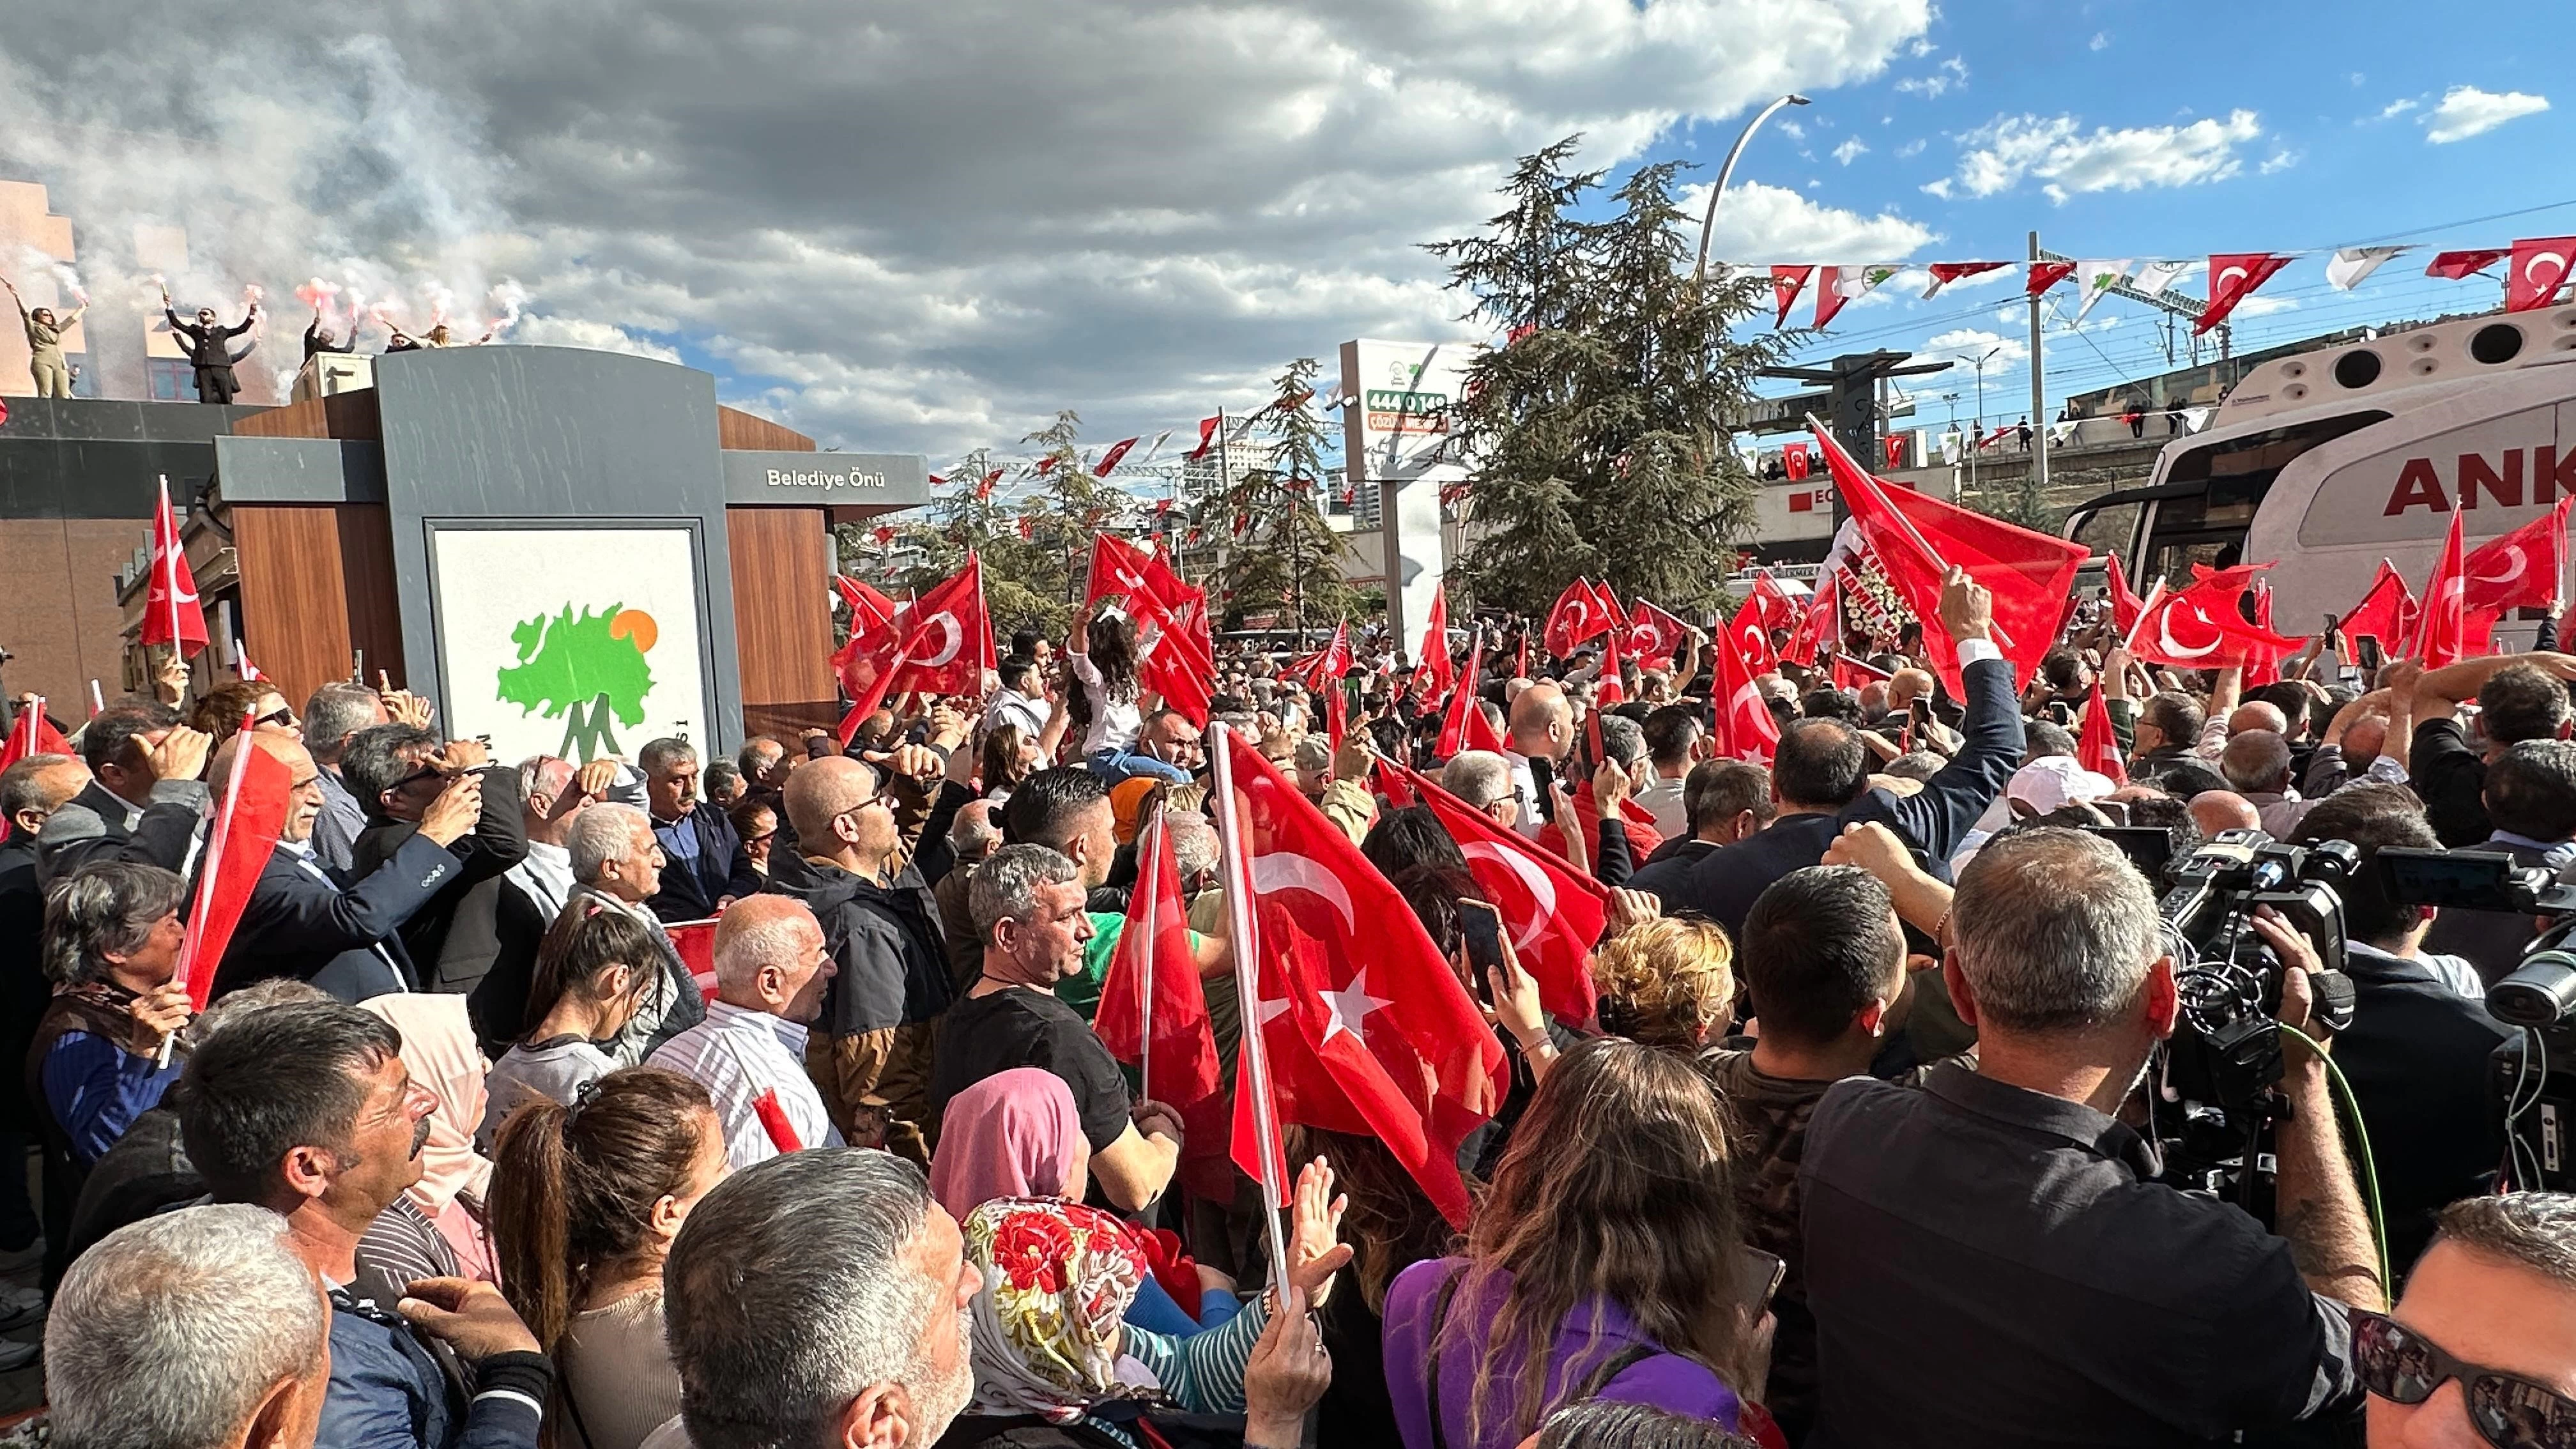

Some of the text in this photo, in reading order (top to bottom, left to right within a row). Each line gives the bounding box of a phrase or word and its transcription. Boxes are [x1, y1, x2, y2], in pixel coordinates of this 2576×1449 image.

[1370, 392, 1402, 411] 444
[767, 466, 885, 491] Belediye Önü
[2382, 444, 2576, 517] ANK
